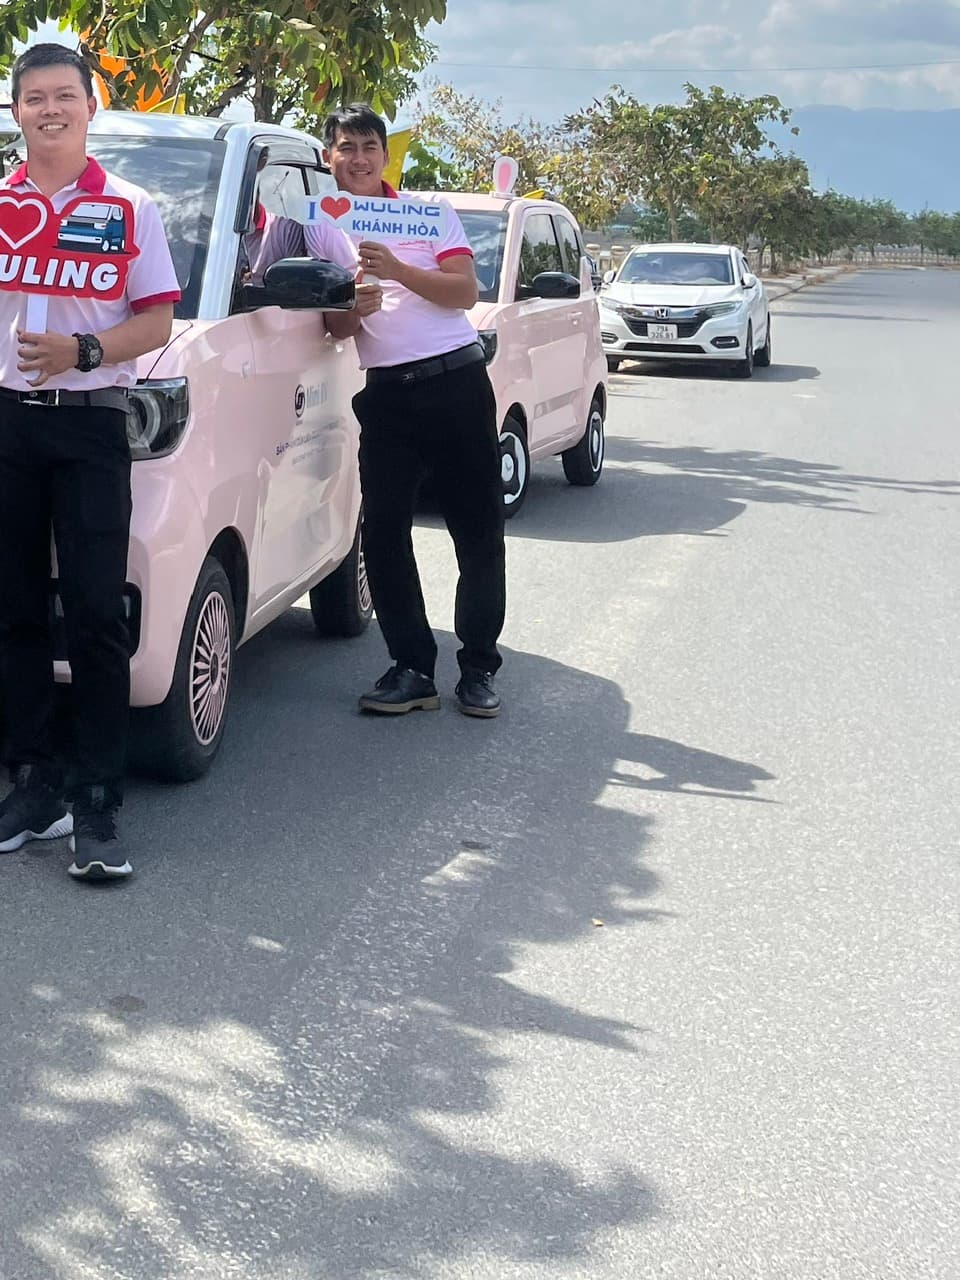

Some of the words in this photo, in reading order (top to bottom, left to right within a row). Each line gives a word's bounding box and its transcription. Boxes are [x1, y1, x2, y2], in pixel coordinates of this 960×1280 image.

[308, 201, 317, 221] I
[353, 200, 441, 217] WULING
[352, 218, 403, 235] KHÁNH
[407, 222, 440, 238] HÒA
